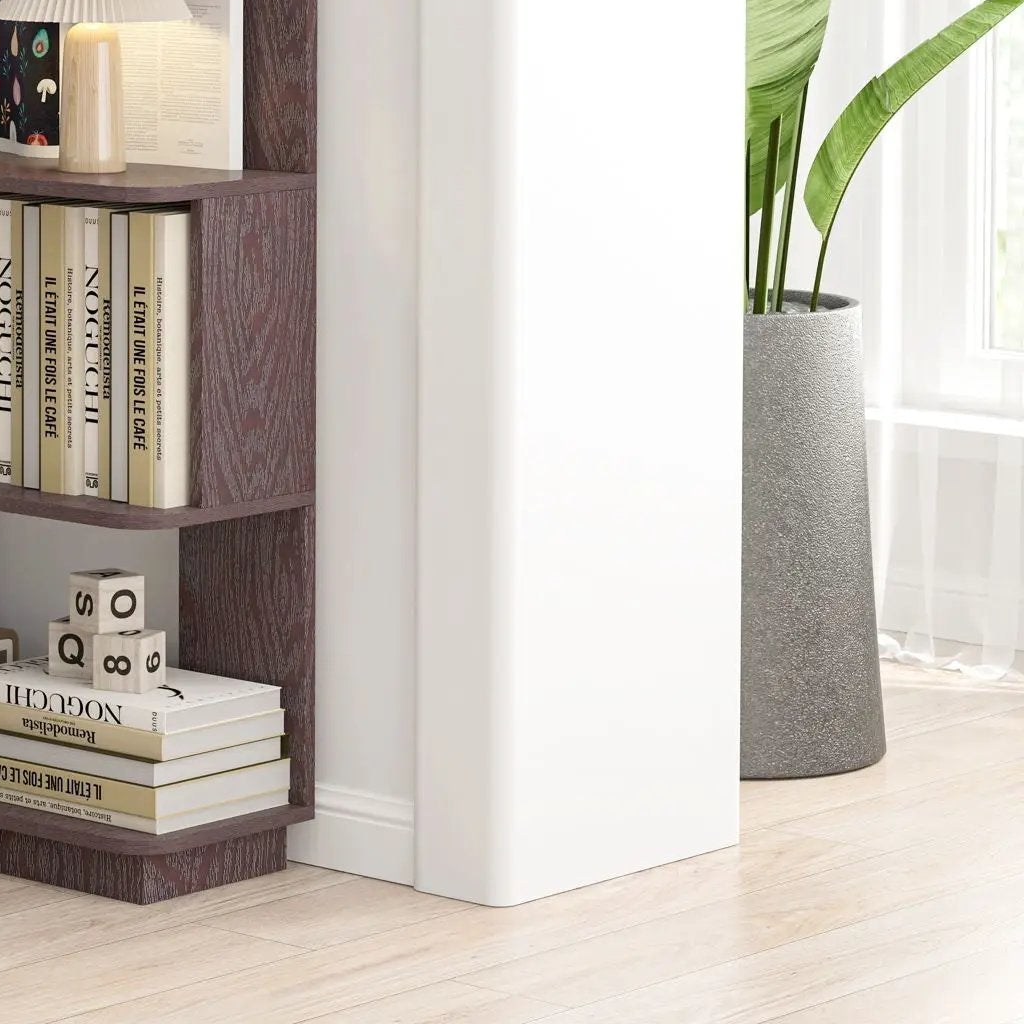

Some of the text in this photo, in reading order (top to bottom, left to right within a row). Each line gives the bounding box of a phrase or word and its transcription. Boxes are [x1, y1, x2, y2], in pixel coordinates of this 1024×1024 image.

[85, 264, 98, 424] NOGUCHI
[133, 286, 148, 451] IL ÉTAIT UNE FOIS LE CAFÉ
[58, 633, 85, 668] Q
[103, 655, 132, 676] 8
[6, 684, 123, 725] NOGUCHI
[22, 717, 96, 744] Remodelista
[9, 766, 20, 782] LE
[22, 769, 43, 787] FOIS
[46, 774, 64, 792] UNE
[65, 782, 91, 801] ÉTAIT
[93, 787, 102, 800] IL
